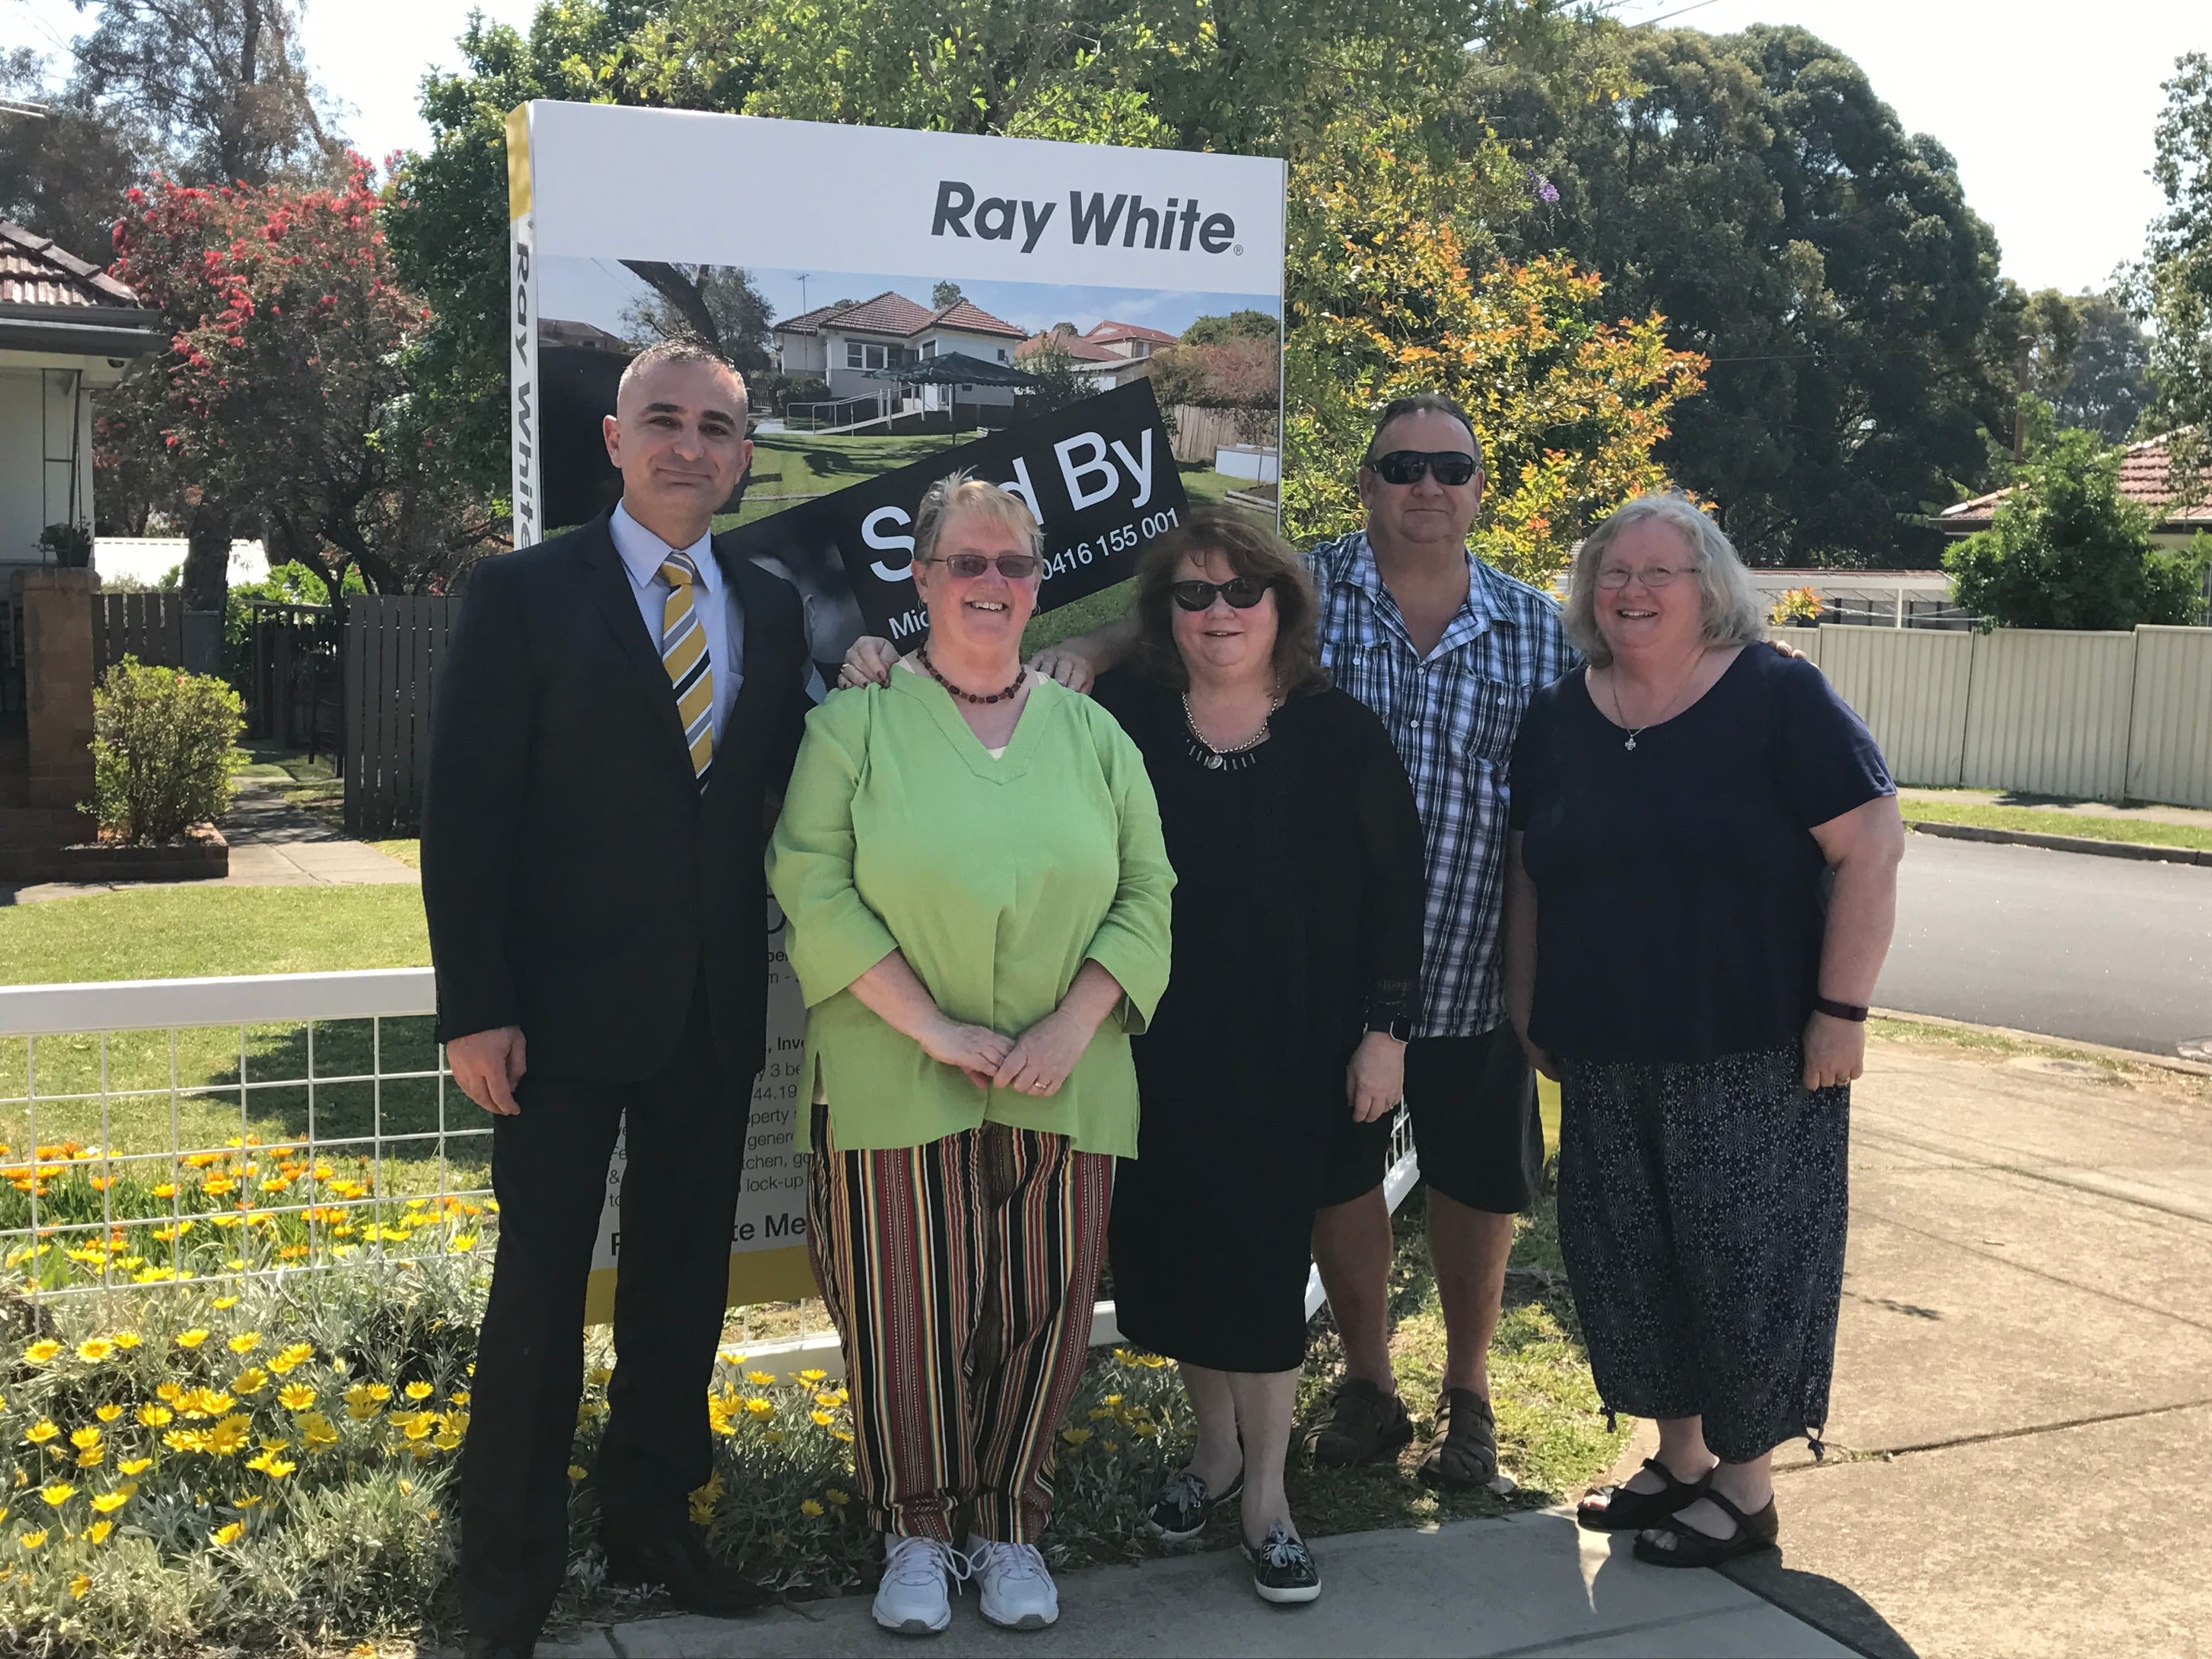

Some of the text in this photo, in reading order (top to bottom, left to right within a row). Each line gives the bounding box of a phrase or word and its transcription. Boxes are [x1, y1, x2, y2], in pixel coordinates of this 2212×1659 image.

[930, 180, 1235, 255] Ray White
[515, 241, 529, 368] Ray
[1053, 427, 1153, 512] By
[1042, 542, 1093, 581] 0416
[1096, 524, 1138, 557] 155
[1129, 507, 1180, 539] 001
[771, 1063, 781, 1078] 3
[749, 1108, 790, 1128] perty
[747, 1175, 804, 1192] lock-up
